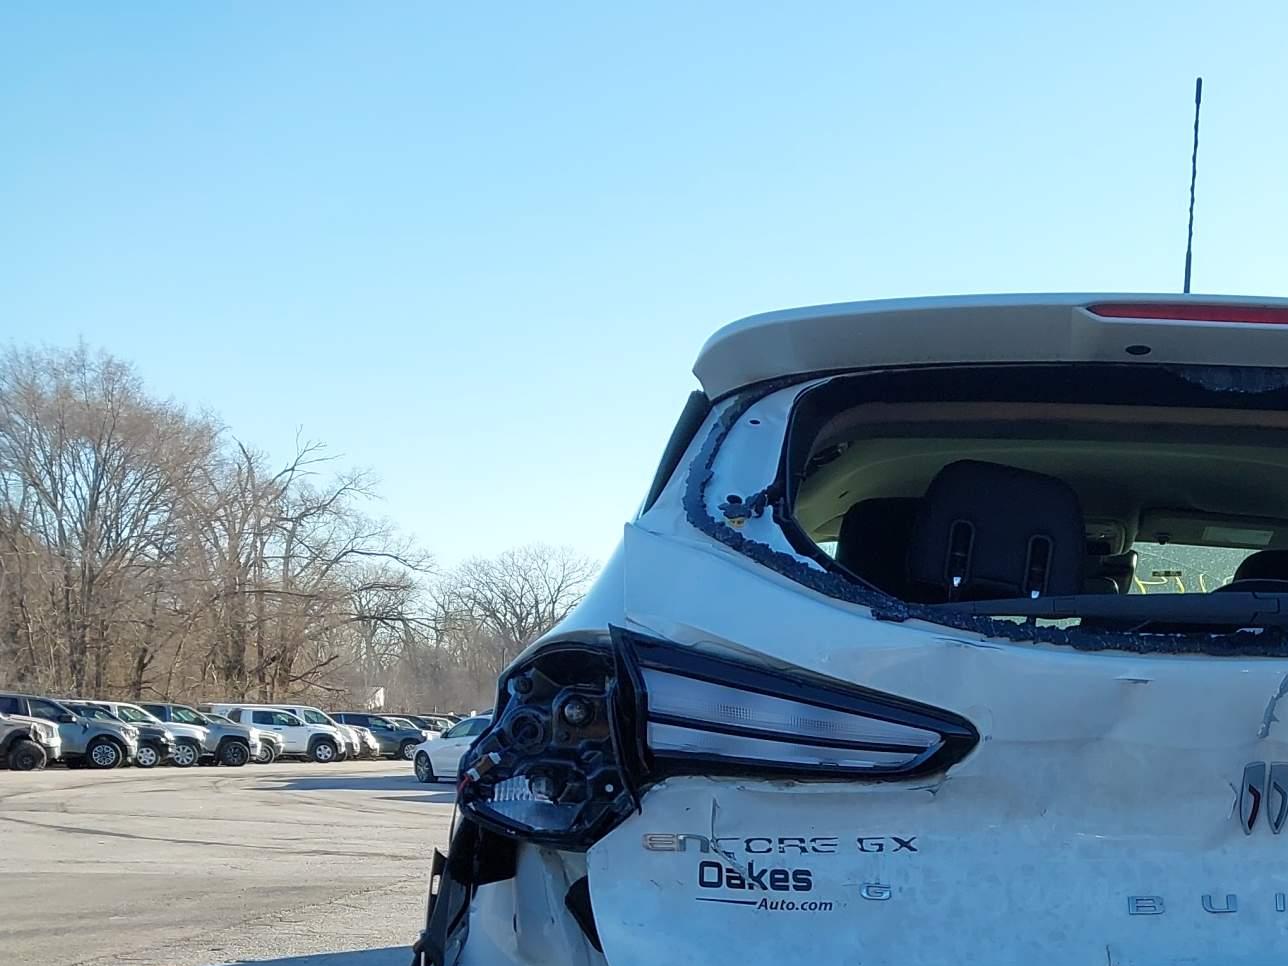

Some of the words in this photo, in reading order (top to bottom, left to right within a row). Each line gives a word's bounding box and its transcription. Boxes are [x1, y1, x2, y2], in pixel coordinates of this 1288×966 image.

[857, 836, 918, 853] GX
[698, 859, 813, 892] Oakes
[757, 897, 834, 912] Auto.com
